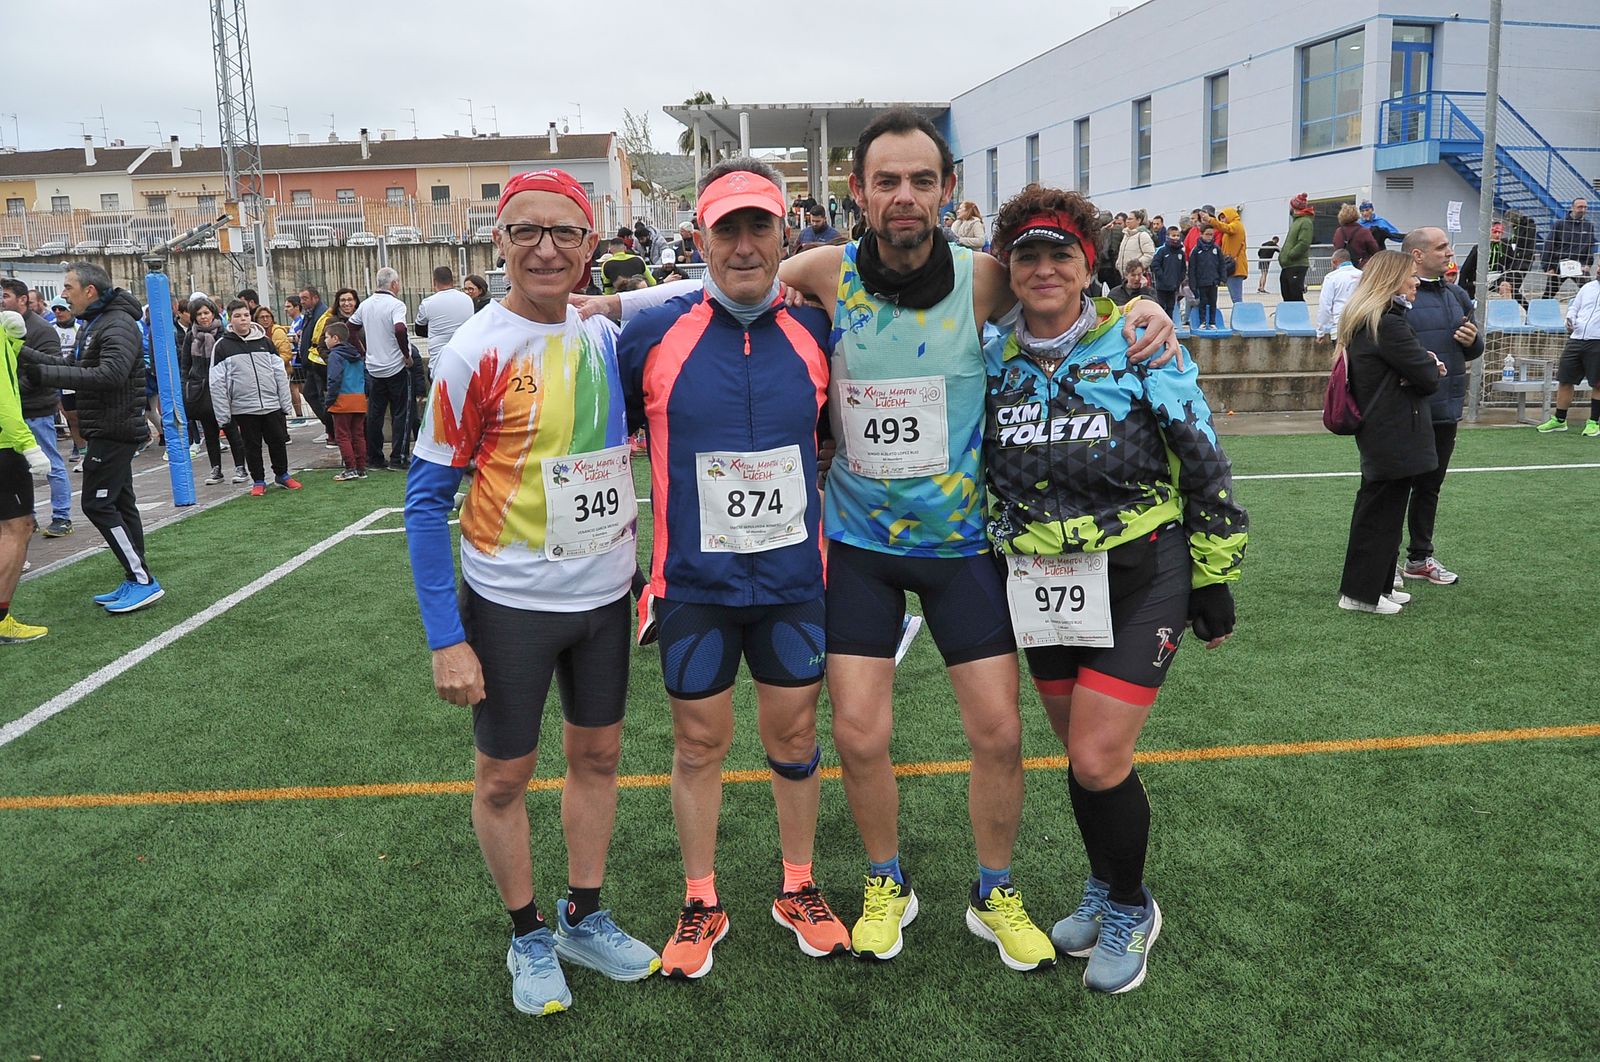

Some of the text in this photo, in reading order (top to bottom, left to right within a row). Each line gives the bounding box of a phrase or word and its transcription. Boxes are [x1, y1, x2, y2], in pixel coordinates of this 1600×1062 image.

[1028, 228, 1065, 240] Lentos
[511, 375, 537, 394] 23
[875, 398, 910, 408] LUCENA
[997, 403, 1041, 425] CXM
[863, 417, 920, 444] 493
[1000, 414, 1109, 446] TOLETA
[585, 470, 610, 481] LUCENA
[743, 470, 775, 481] LUCENA
[574, 488, 619, 522] 349
[727, 488, 783, 517] 874
[1045, 567, 1078, 576] LUCENA
[1035, 585, 1085, 612] 979
